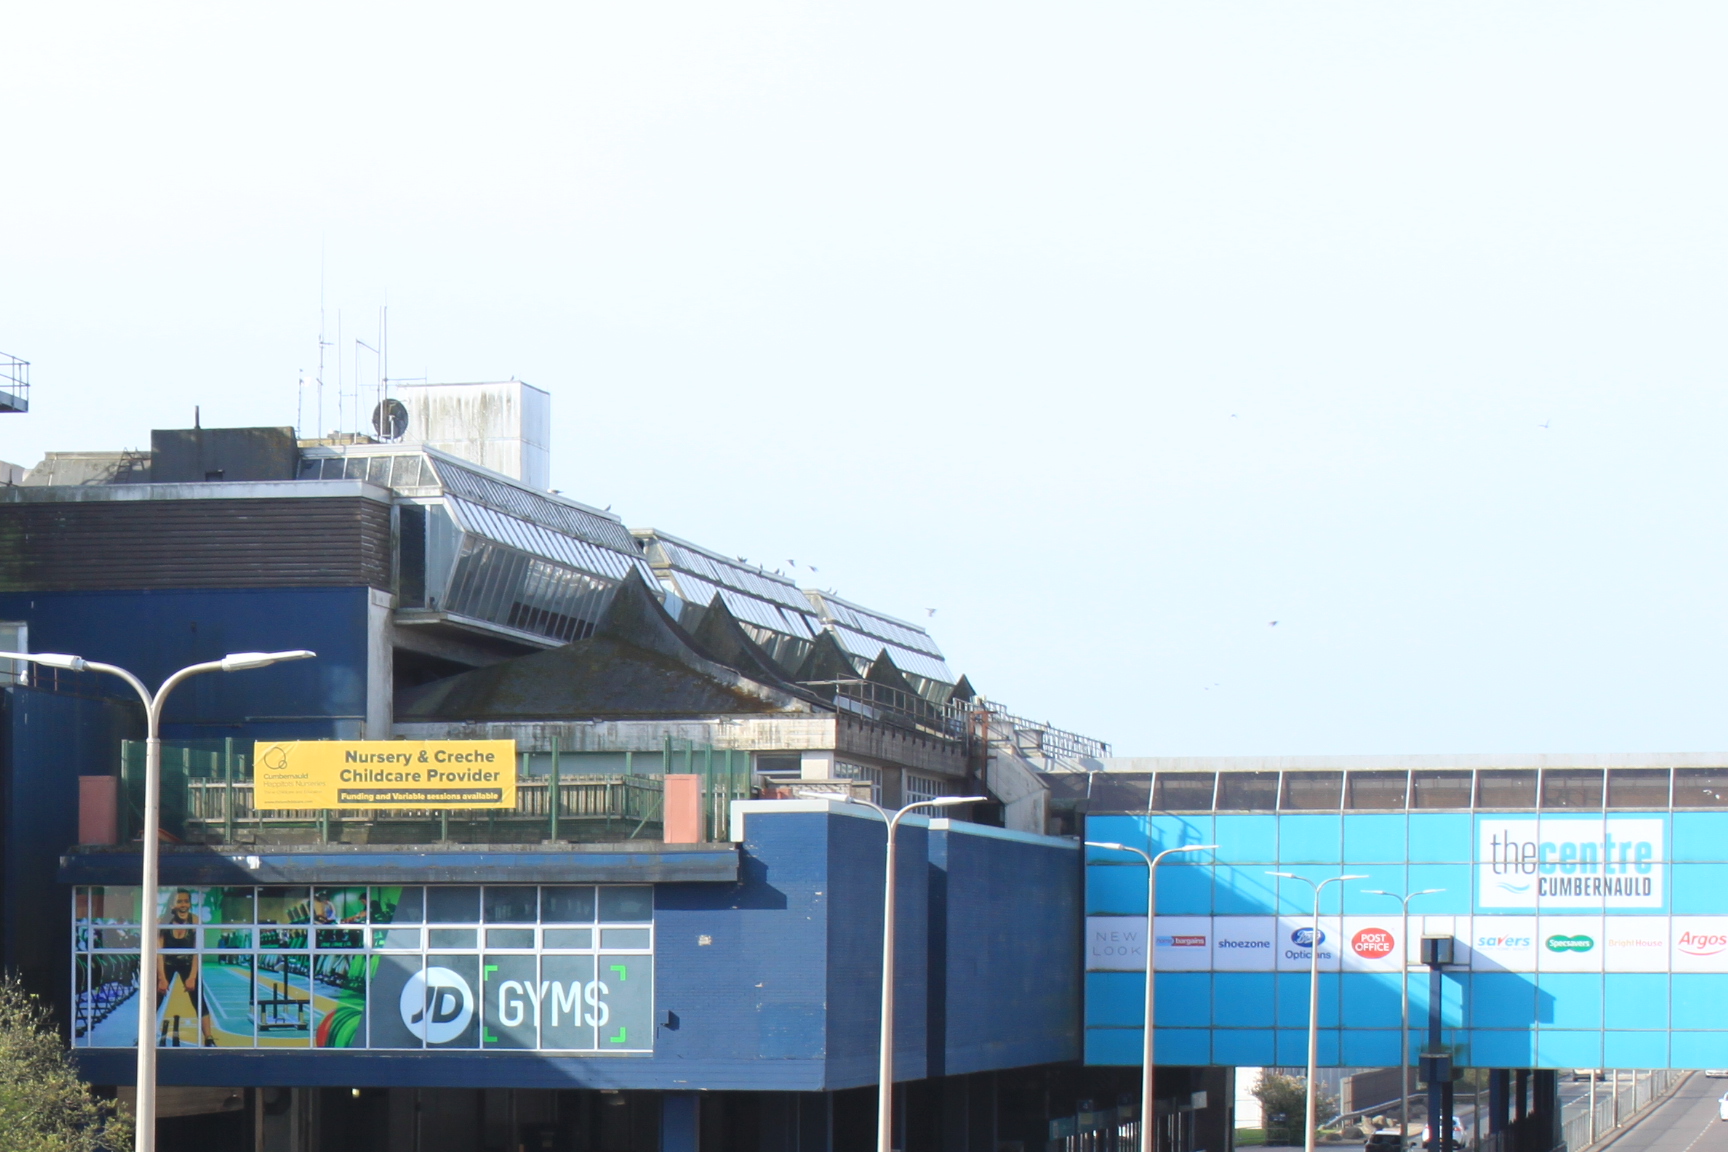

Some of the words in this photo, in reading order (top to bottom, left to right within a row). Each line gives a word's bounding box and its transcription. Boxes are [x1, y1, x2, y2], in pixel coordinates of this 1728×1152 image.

[345, 750, 412, 766] Nursery
[417, 750, 429, 763] &
[434, 750, 495, 763] Creche
[339, 769, 421, 782] Childcare
[427, 768, 500, 782] Provider
[341, 792, 374, 802] Funding
[375, 792, 391, 800] and
[392, 792, 425, 800] Variable
[427, 792, 461, 800] sessions
[462, 792, 498, 800] available
[1539, 877, 1651, 896] CUMBERNAULD
[1096, 931, 1138, 942] NEW
[1175, 937, 1205, 946] bargains
[1360, 934, 1386, 943] POST
[1478, 934, 1530, 947] savers
[1678, 931, 1727, 949] Argos
[1218, 939, 1270, 948] shoezone
[1355, 943, 1390, 952] OFFICE
[1549, 939, 1591, 948] Specsavers
[1092, 946, 1141, 956] LOOK
[1285, 950, 1332, 960] Opticns
[411, 986, 464, 1024] JD
[498, 980, 610, 1027] GYMS
